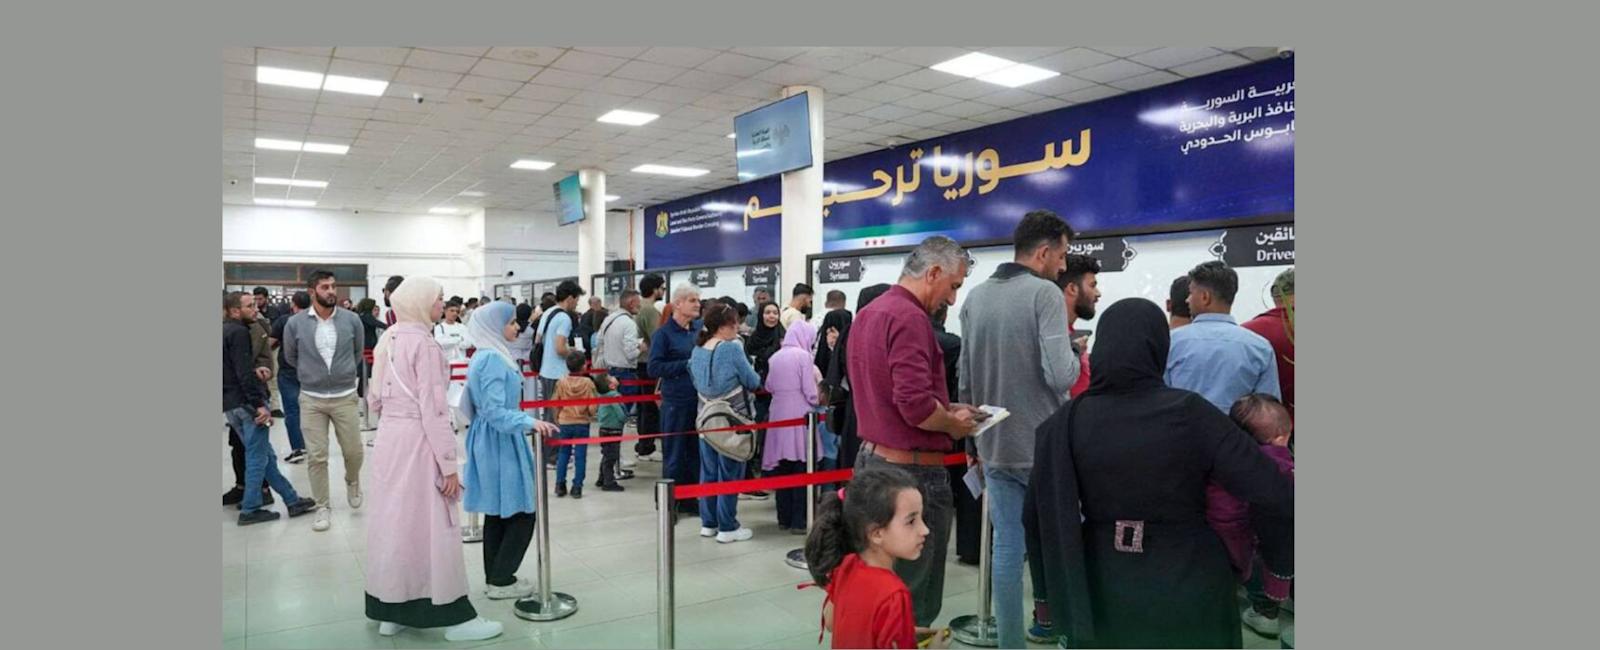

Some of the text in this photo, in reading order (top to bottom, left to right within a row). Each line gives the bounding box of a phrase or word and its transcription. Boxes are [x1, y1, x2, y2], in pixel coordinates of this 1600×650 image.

[1179, 114, 1226, 134] والبحرية
[1228, 106, 1262, 125] البرية
[1180, 129, 1241, 155] الحدودي
[933, 128, 1091, 200] سوريا
